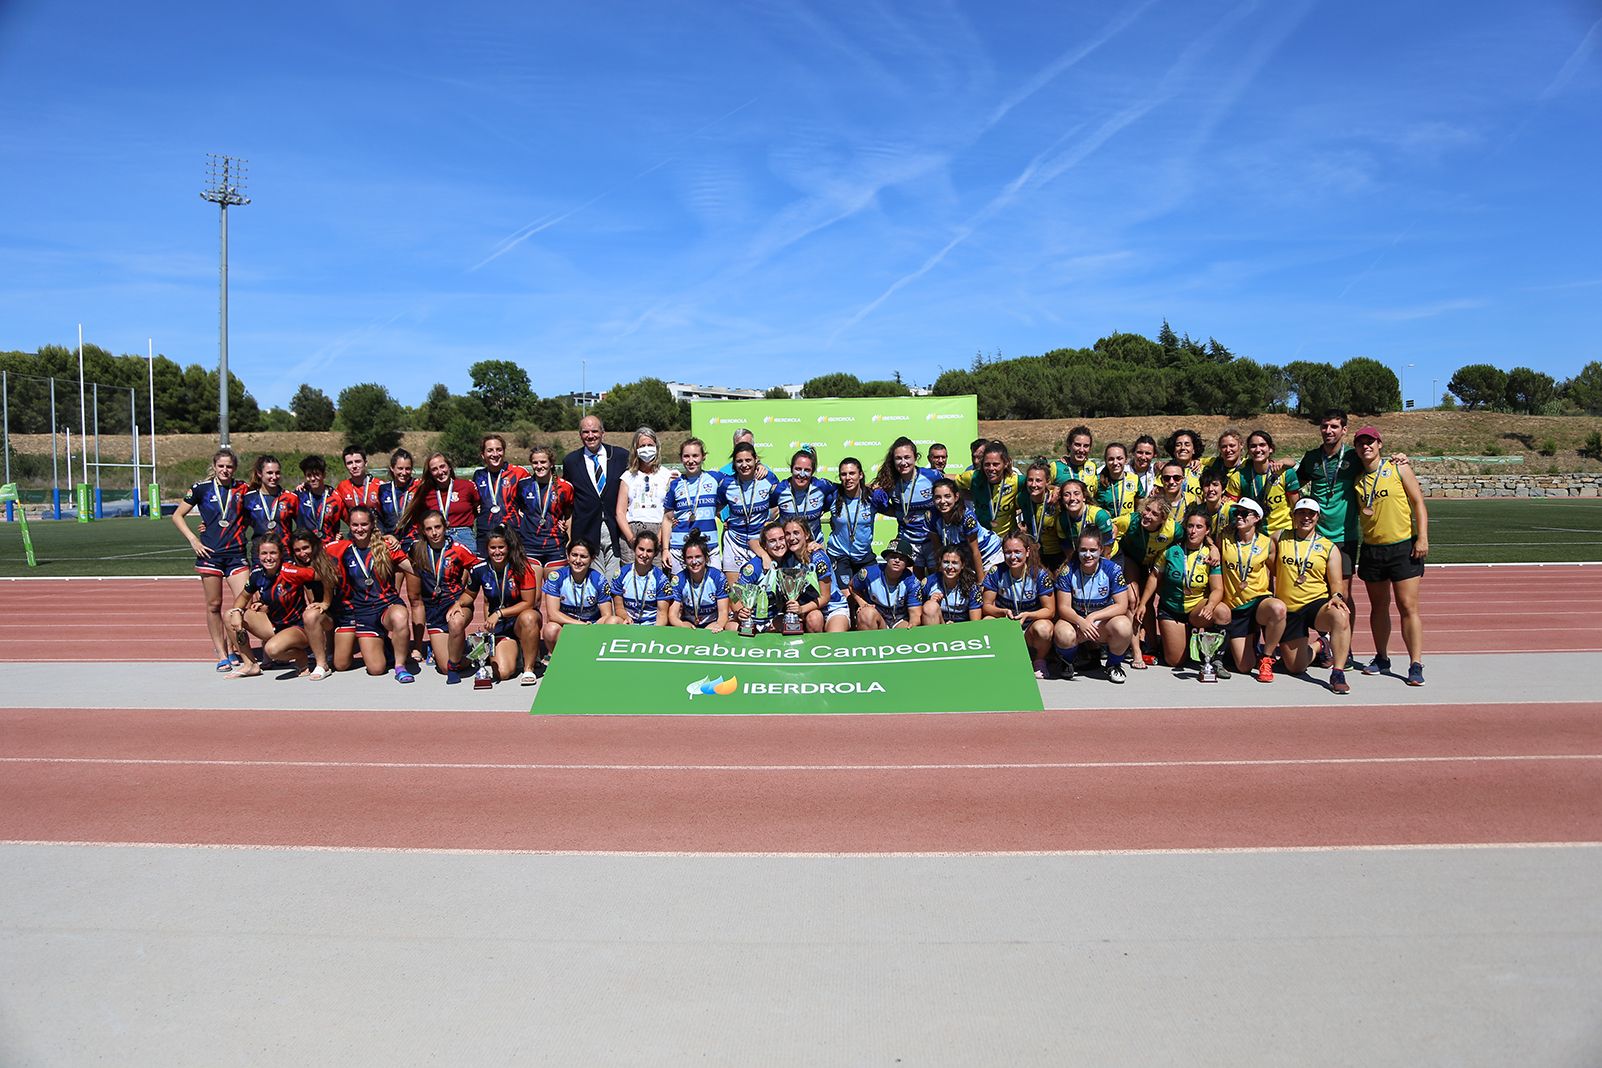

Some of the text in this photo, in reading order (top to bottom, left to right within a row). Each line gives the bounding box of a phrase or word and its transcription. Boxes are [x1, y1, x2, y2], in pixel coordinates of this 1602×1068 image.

[598, 634, 992, 659] ¡Enhorabuena Campeonas!
[743, 680, 886, 695] IBERDROLA
